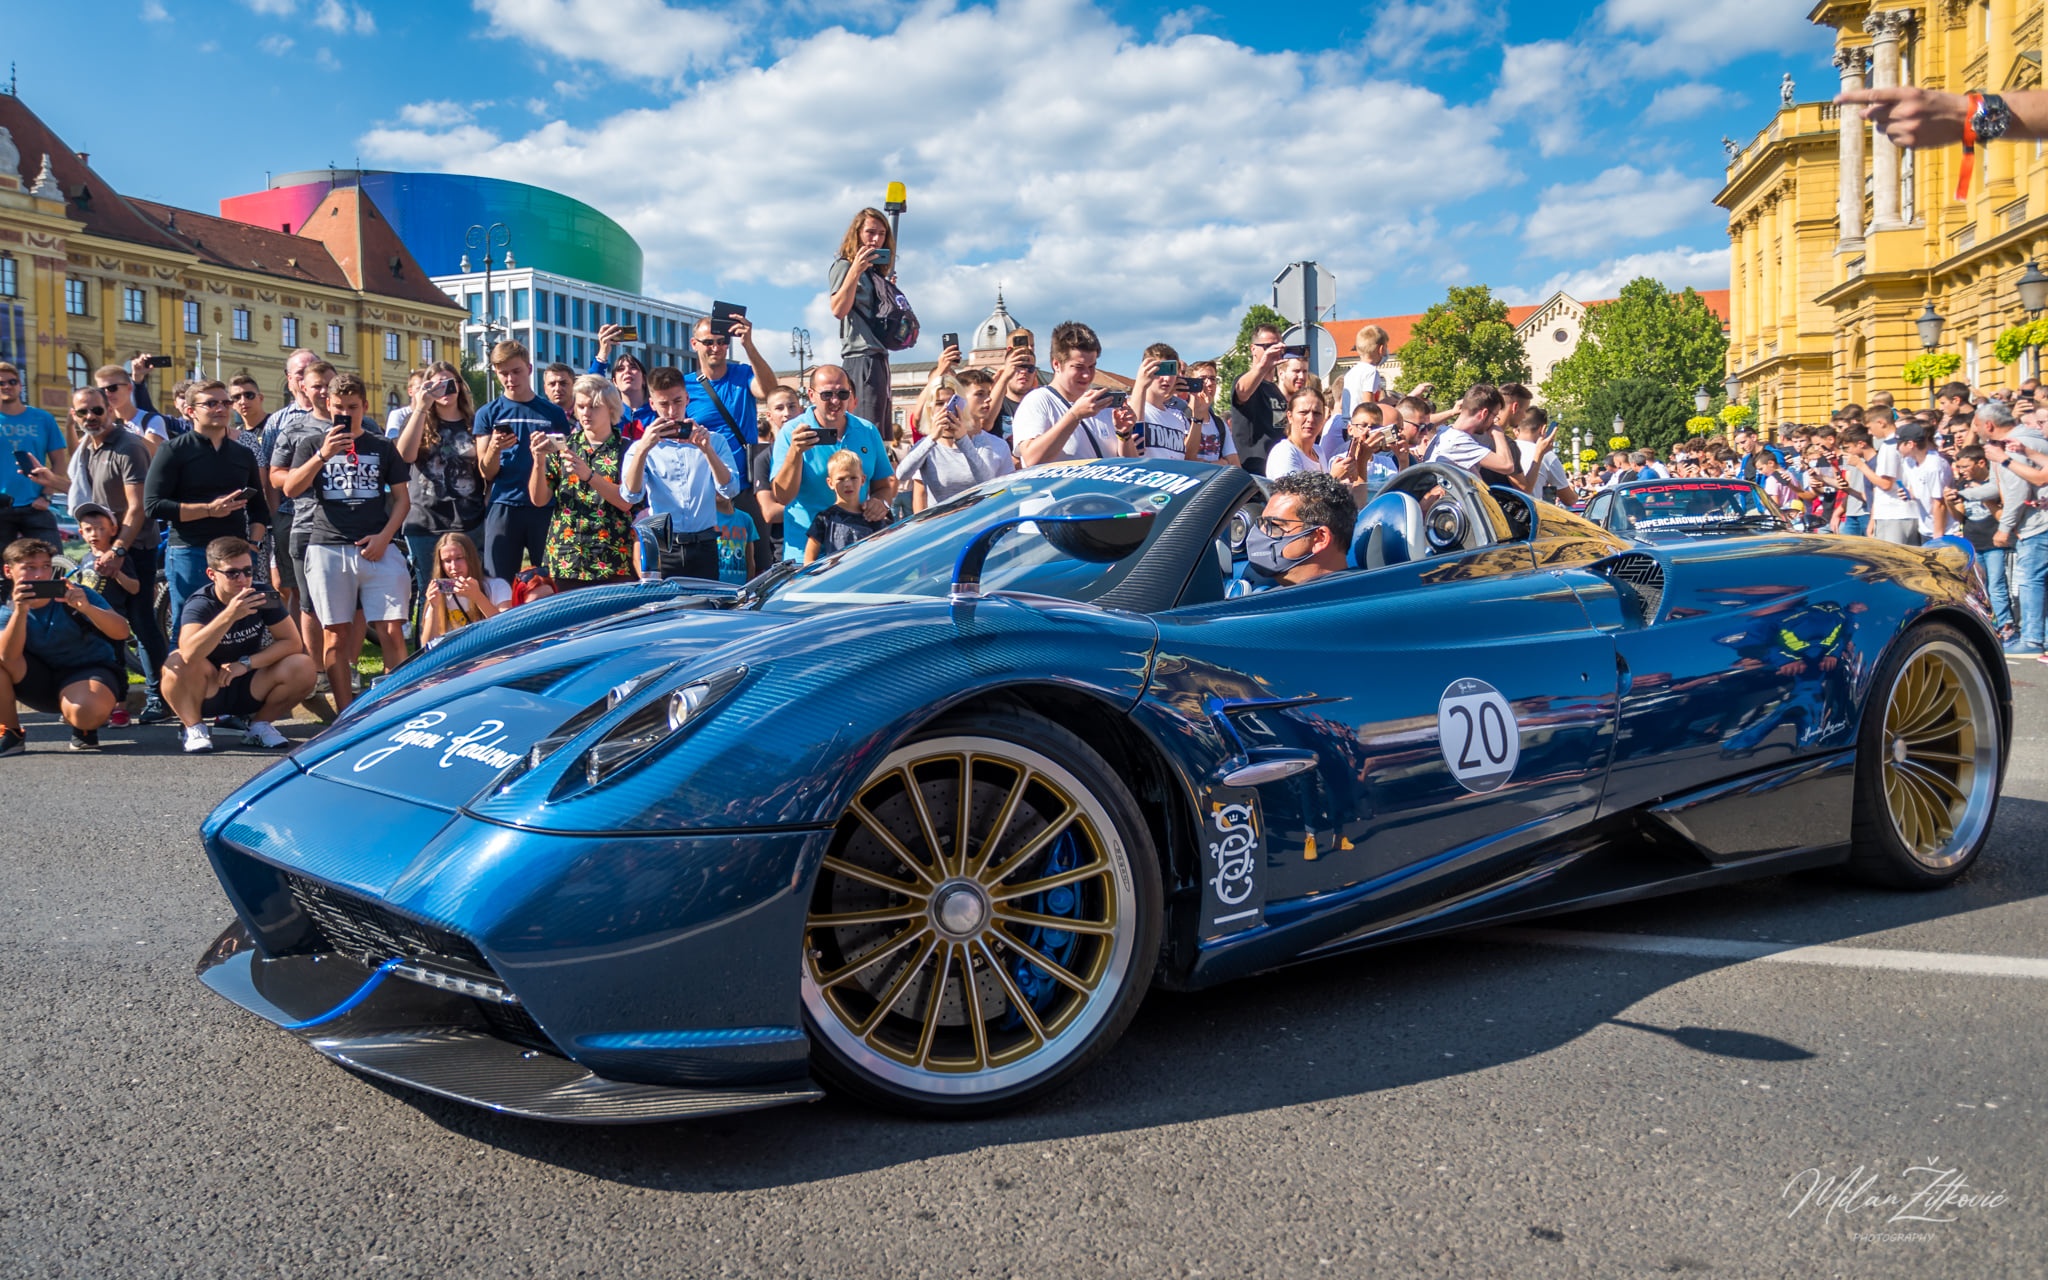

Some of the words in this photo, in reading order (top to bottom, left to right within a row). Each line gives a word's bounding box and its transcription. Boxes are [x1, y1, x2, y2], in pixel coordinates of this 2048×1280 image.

[0, 423, 39, 437] OBE
[1148, 423, 1185, 453] TOMM
[323, 475, 379, 490] JONES
[1629, 484, 1751, 495] PORSCHE
[1449, 701, 1508, 770] 20
